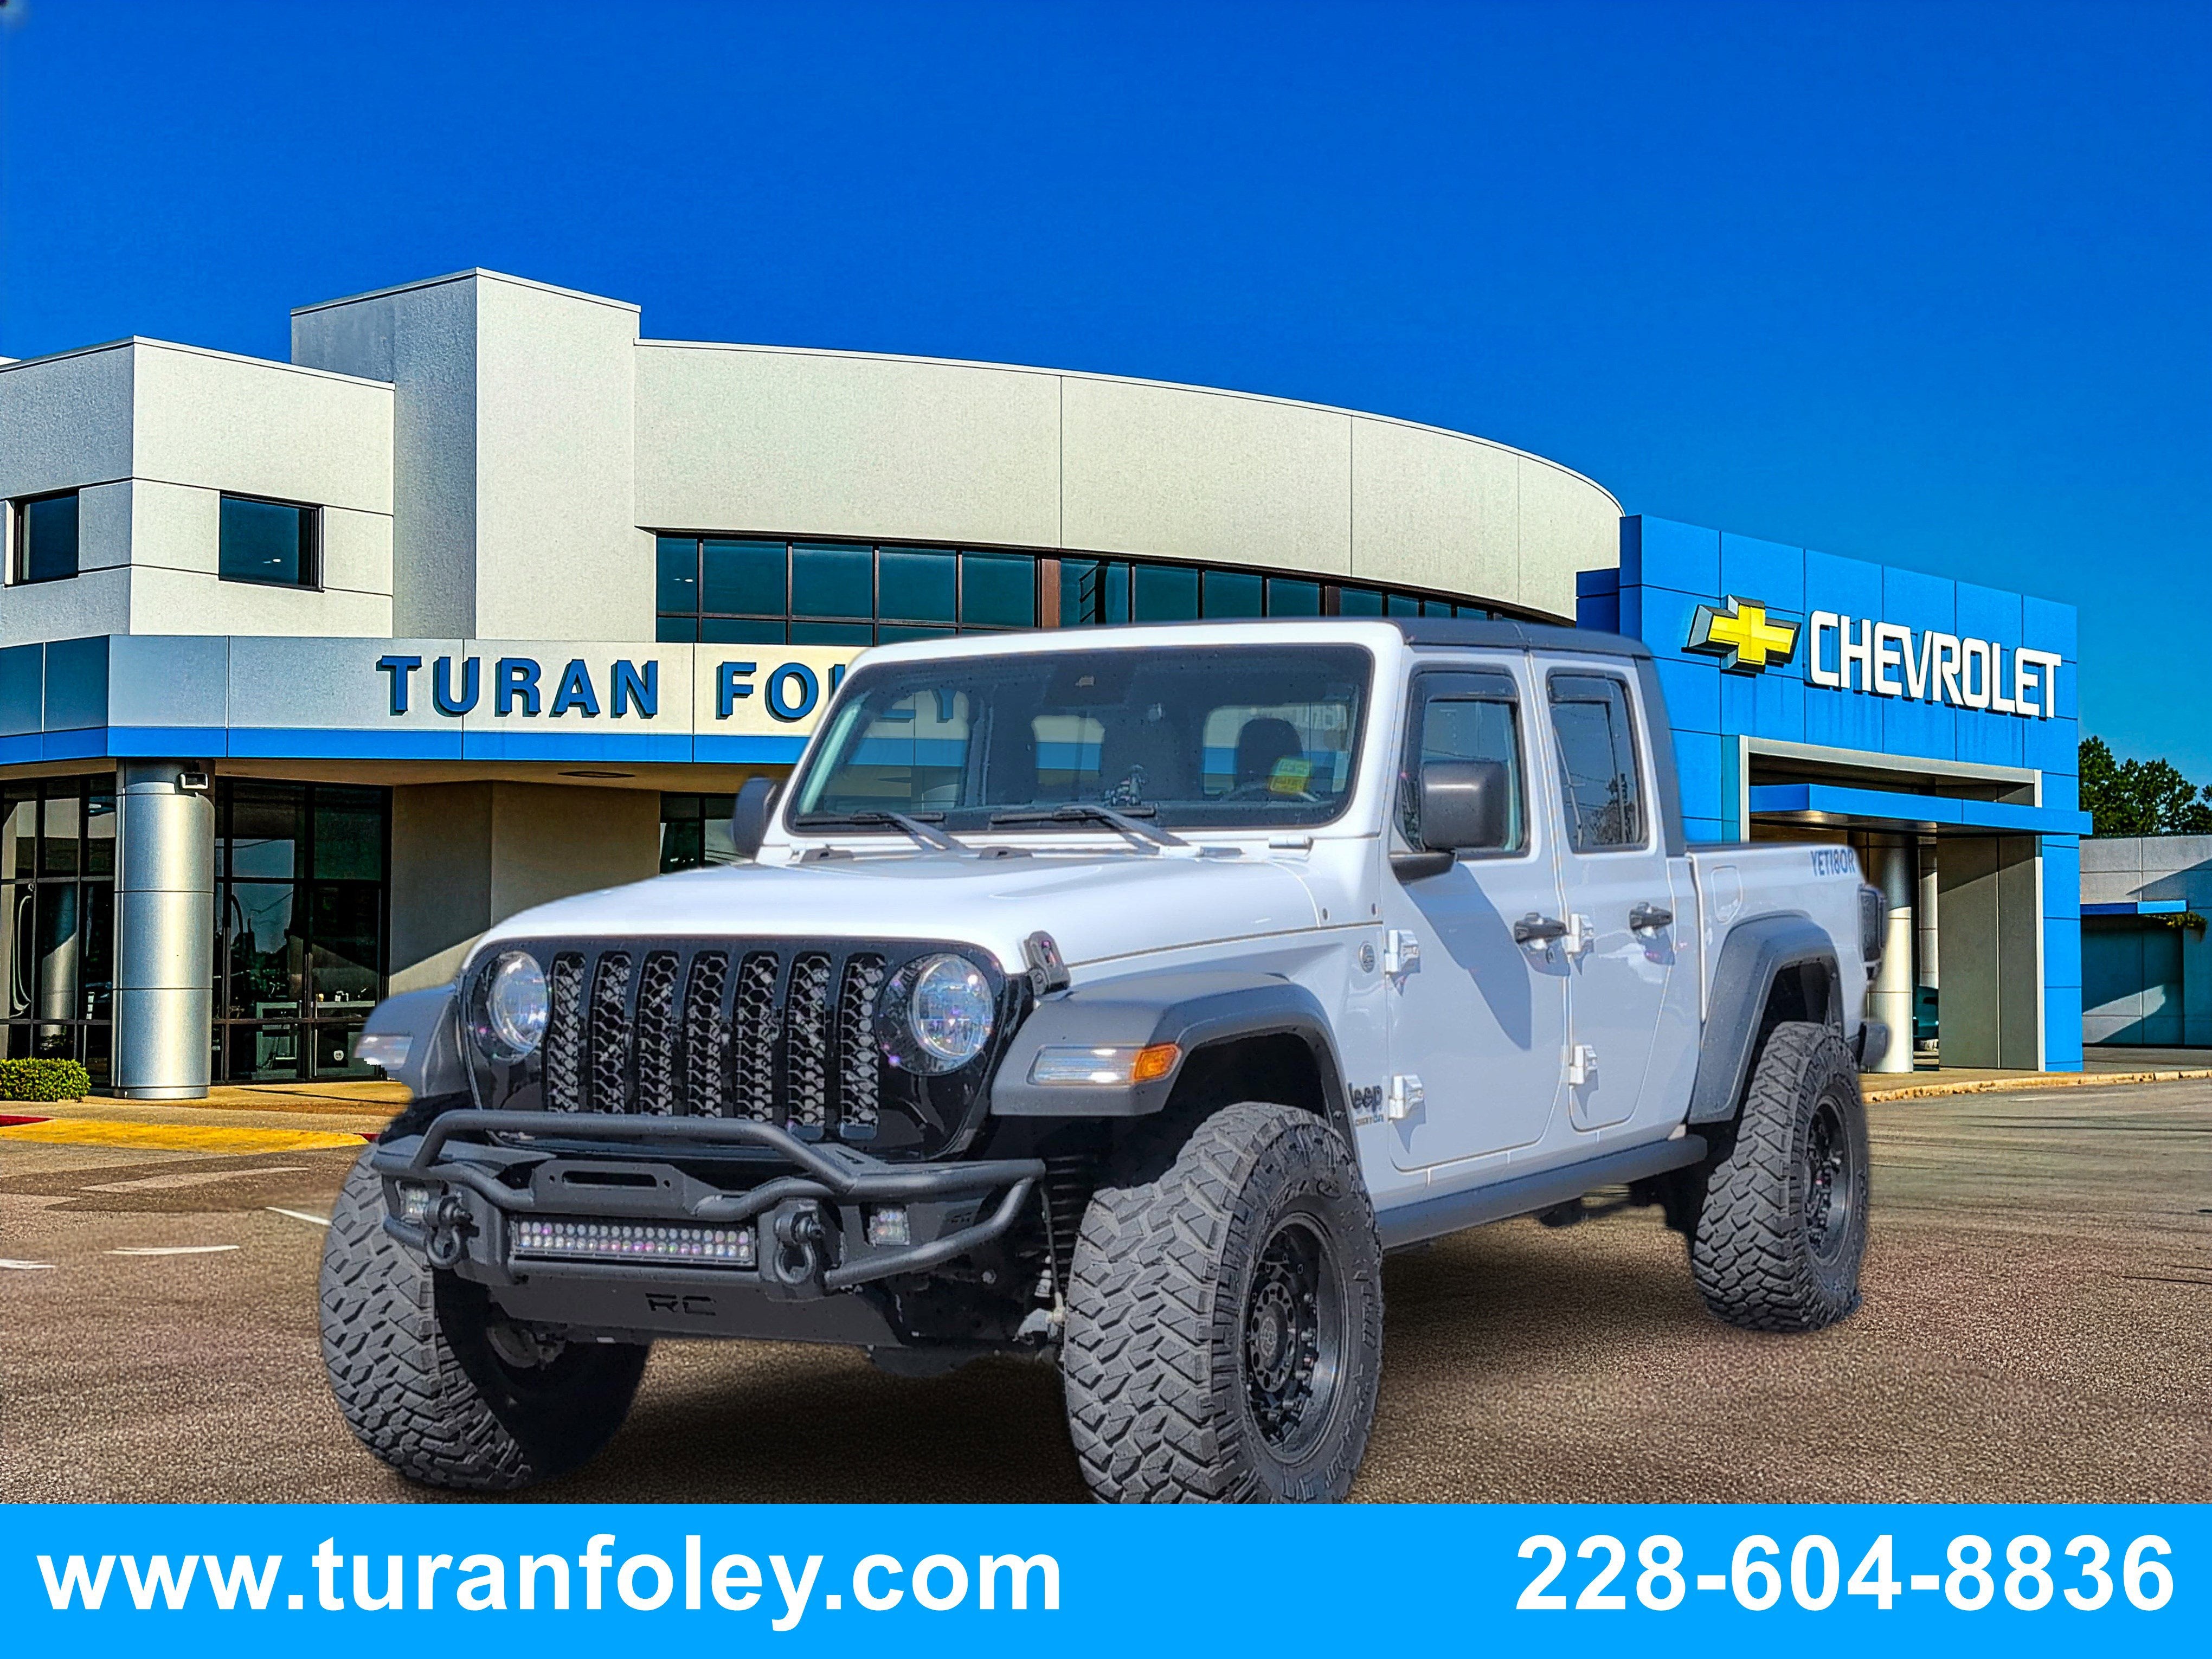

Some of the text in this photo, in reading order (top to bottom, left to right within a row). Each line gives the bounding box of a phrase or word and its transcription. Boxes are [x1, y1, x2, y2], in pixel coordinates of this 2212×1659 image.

[376, 655, 659, 719] TURAN
[1810, 610, 2062, 718] CHEVROLET
[1348, 1082, 1382, 1113] Jeep
[645, 1293, 717, 1316] RC
